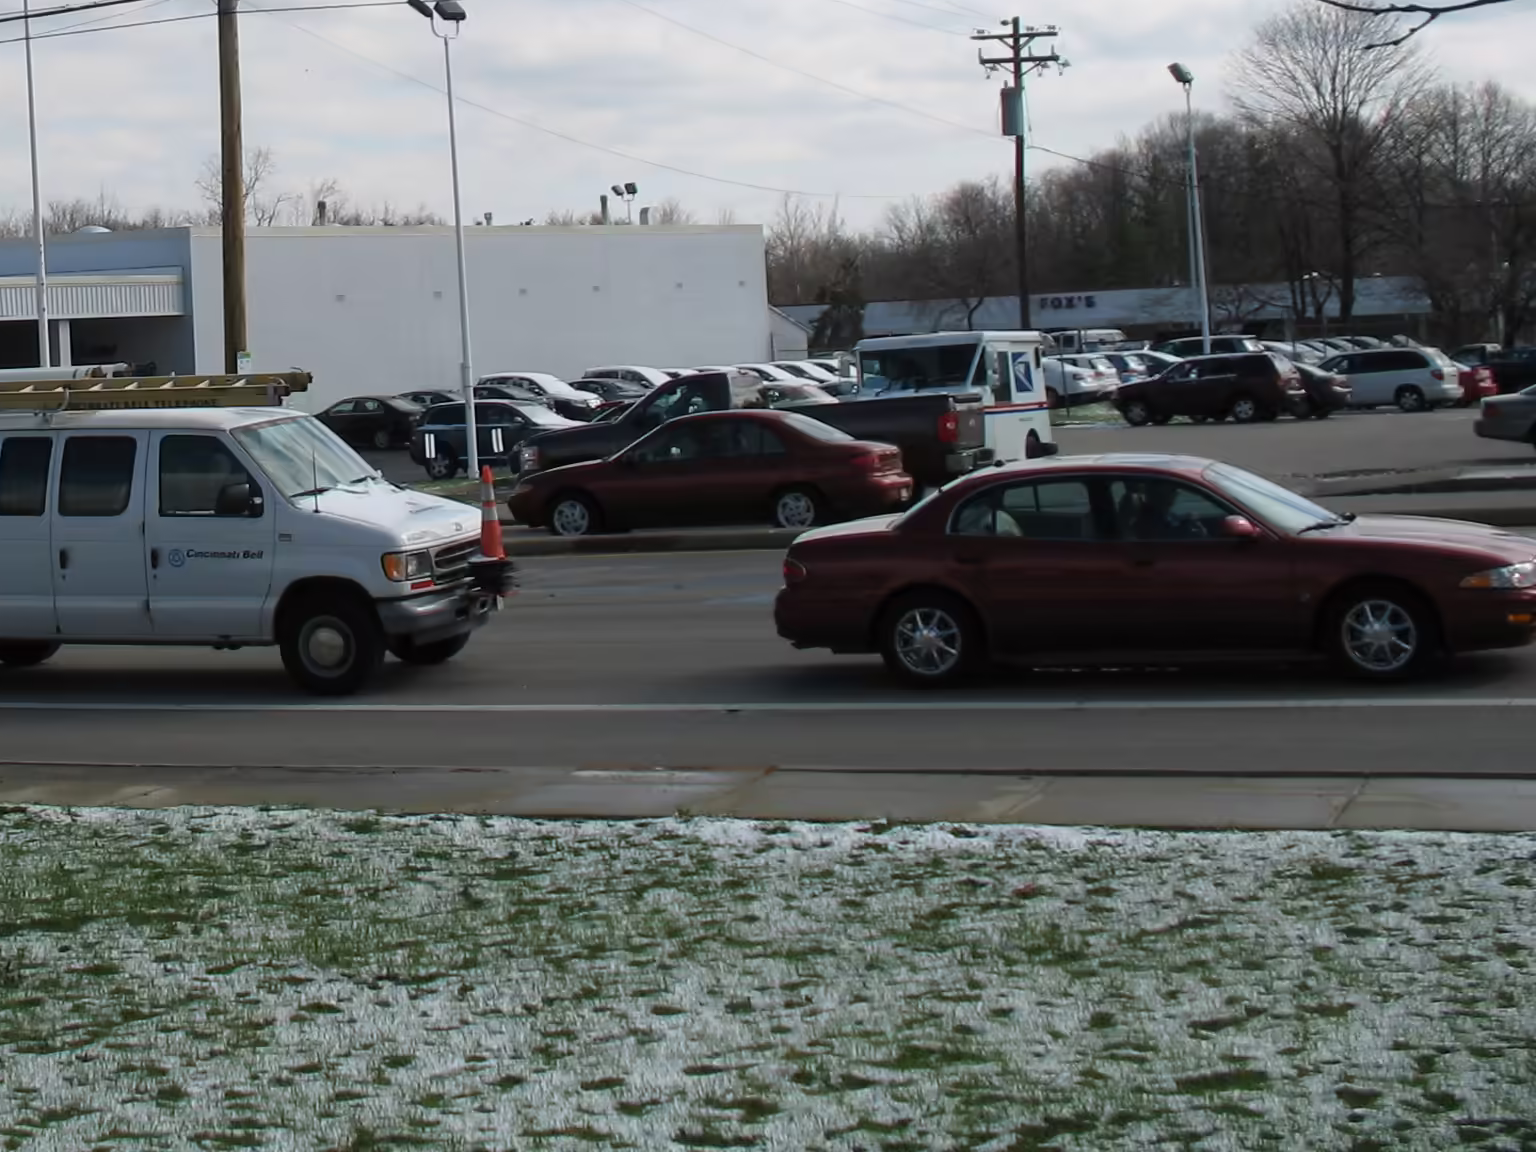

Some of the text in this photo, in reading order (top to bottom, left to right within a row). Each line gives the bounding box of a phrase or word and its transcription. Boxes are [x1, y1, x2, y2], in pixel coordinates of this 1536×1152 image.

[1040, 295, 1097, 310] FOX'S
[154, 398, 218, 409] TELEPHONE
[186, 548, 264, 560] Cincinnati Bell
